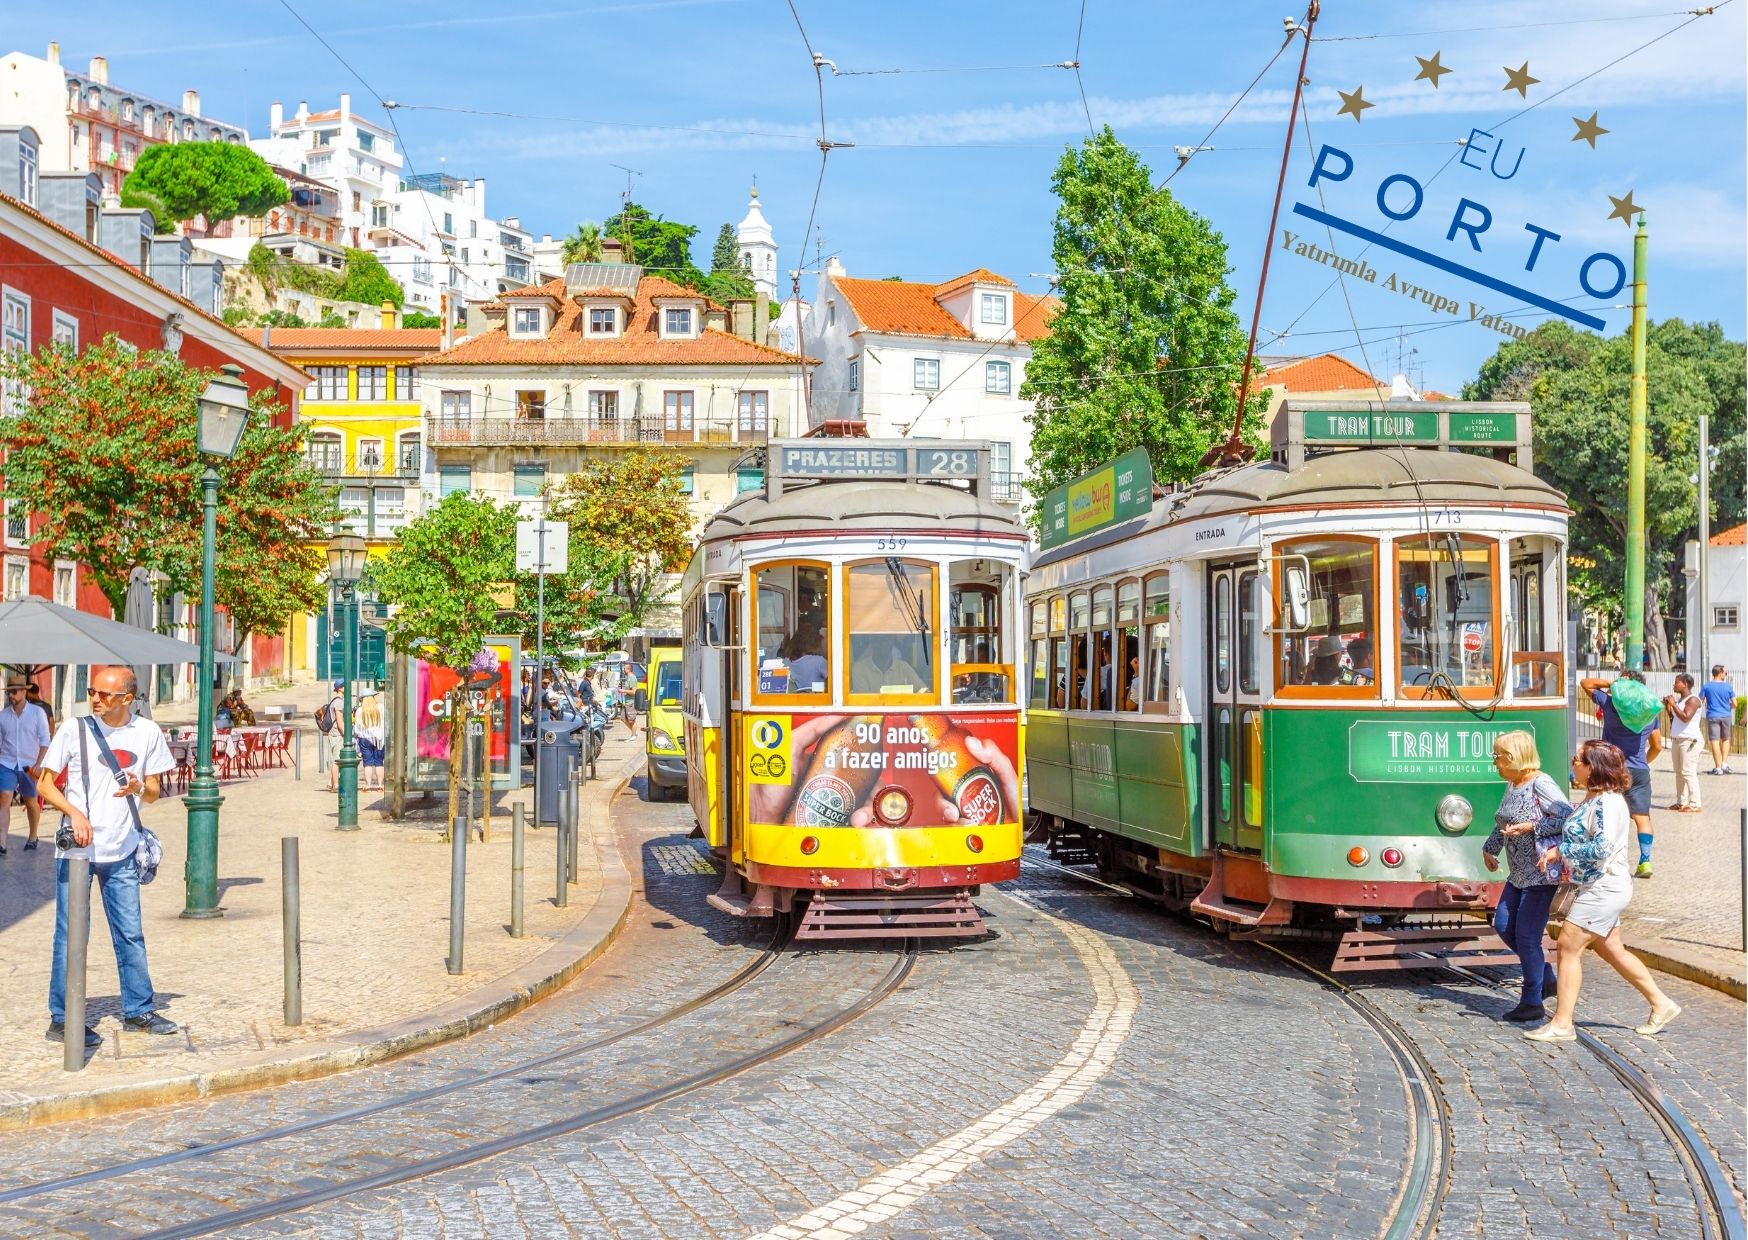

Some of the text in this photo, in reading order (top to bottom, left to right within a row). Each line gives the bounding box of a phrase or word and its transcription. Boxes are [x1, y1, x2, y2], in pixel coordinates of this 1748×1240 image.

[1327, 416, 1415, 436] TRAM TOUR
[1471, 418, 1494, 426] LISBON
[787, 450, 897, 467] PRAZERES
[930, 451, 968, 475] 28
[1434, 510, 1462, 525] 713
[877, 538, 908, 551] 559
[1195, 527, 1226, 542] ENTRADA
[761, 682, 771, 690] 01
[855, 723, 929, 745] 90 anos
[1388, 731, 1505, 758] TRAM TOU
[825, 748, 958, 775] a fazer amigos
[1387, 765, 1422, 773] LISBON
[1428, 765, 1481, 773] HISTORICAL
[803, 794, 826, 815] SUPER
[825, 809, 847, 823] BOCK
[963, 784, 992, 817] SUPER
[971, 794, 997, 824] BOCK
